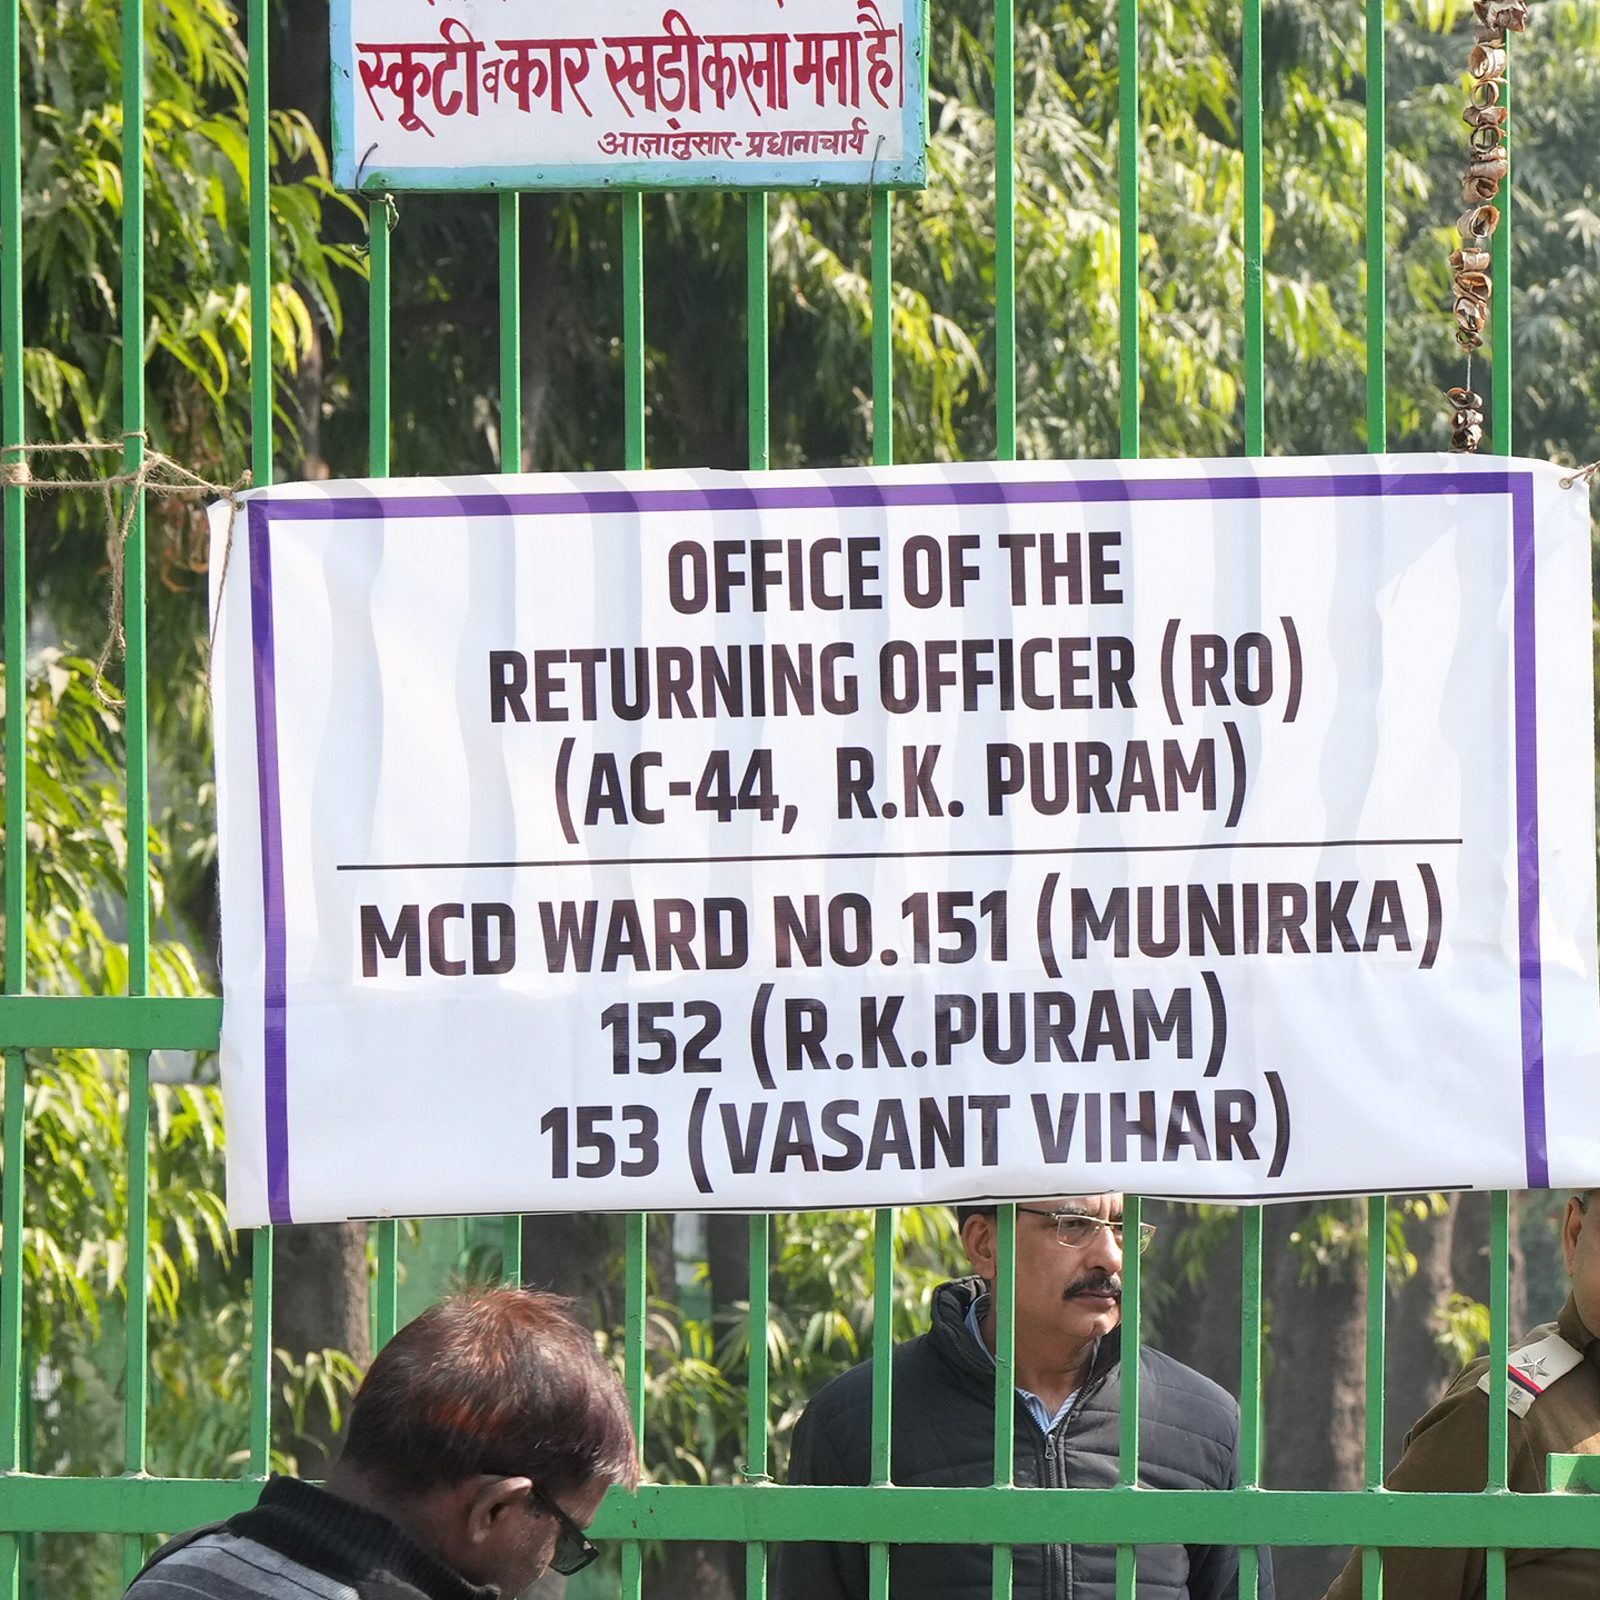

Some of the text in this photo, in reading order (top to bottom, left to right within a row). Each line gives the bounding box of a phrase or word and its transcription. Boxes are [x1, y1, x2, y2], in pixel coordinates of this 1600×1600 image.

[356, 18, 486, 137] स्कूटी
[496, 39, 598, 117] कार
[702, 32, 791, 116] करना
[793, 32, 862, 107] मना
[669, 532, 1123, 614] OFFICE OF THE
[490, 617, 1302, 725] RETURNING OFFICER (RO)
[556, 737, 798, 844] (AC-44,
[987, 722, 1246, 827] PURAM)
[361, 903, 516, 977] MCD
[539, 897, 748, 973] WARD
[1037, 864, 1442, 978] (MUNIRKA)
[601, 971, 1226, 1089] 152 (R.K.PURAM)
[541, 1071, 1290, 1193] 153 (VASANT VIHAR)
